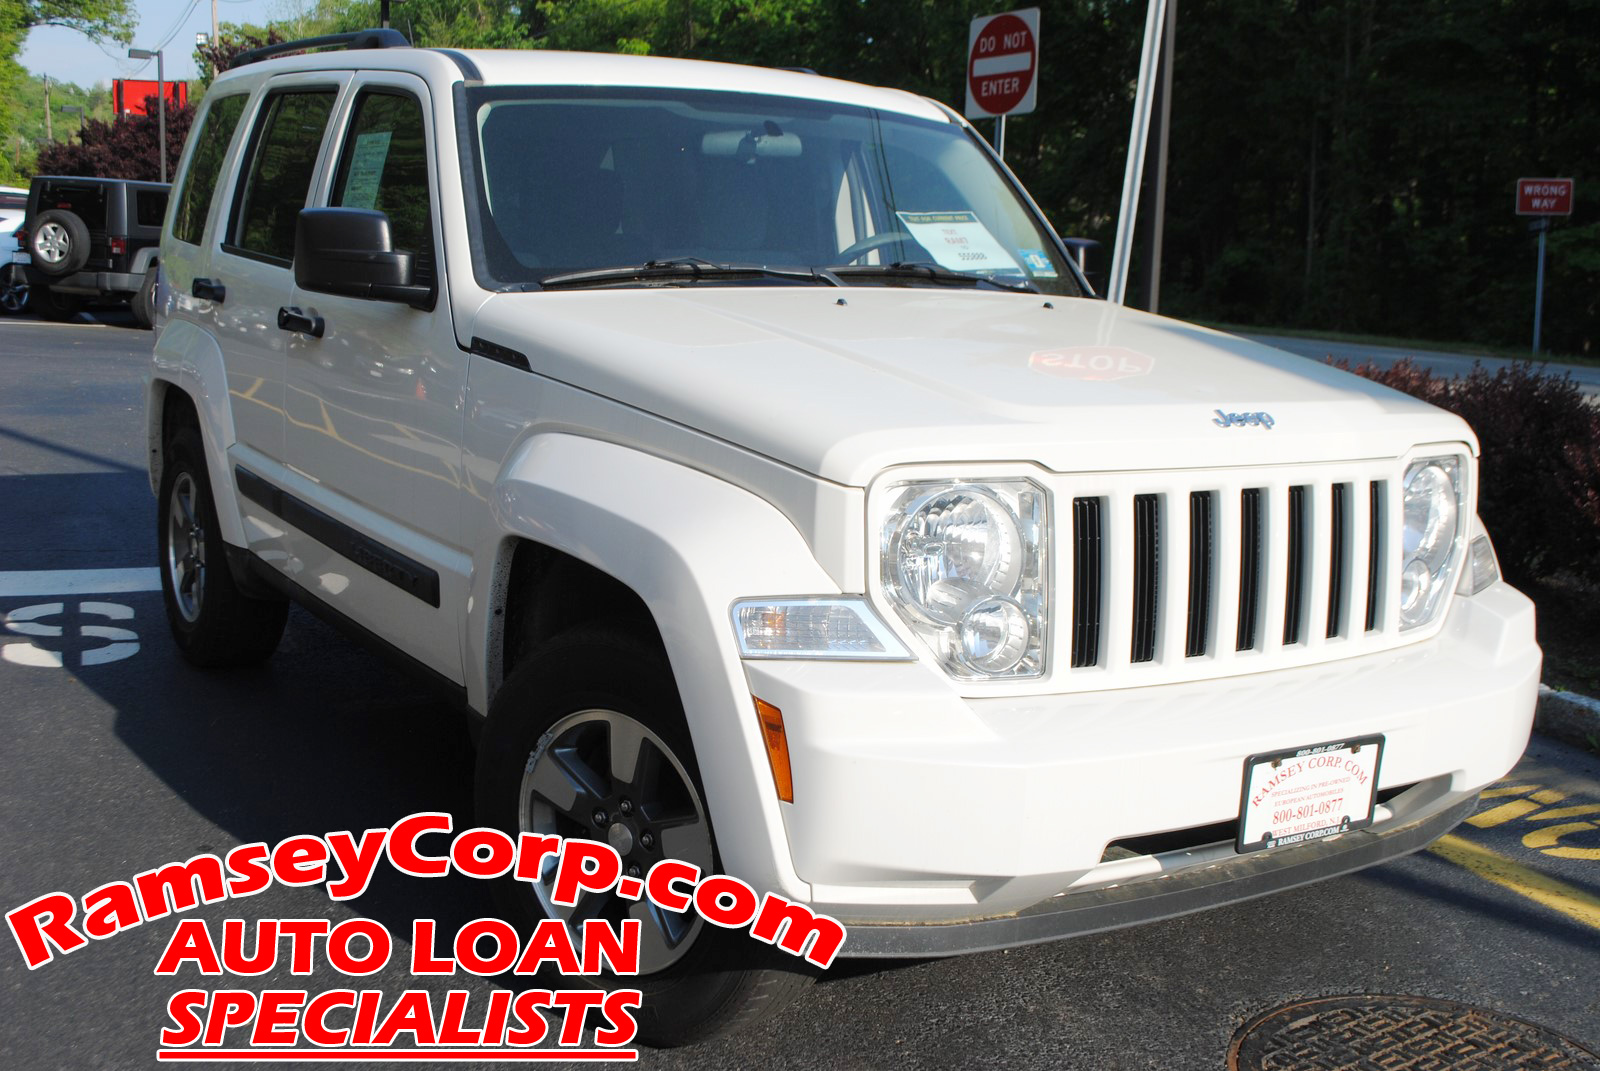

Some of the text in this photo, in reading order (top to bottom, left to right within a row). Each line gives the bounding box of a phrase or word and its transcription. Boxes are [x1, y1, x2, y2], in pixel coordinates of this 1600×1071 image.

[979, 31, 1028, 53] DO NOT
[981, 77, 1020, 97] ENTER
[1523, 184, 1567, 197] WRONG
[1531, 198, 1557, 209] WAY
[1212, 408, 1275, 430] Jeep
[1295, 743, 1346, 757] 800-801-0877
[1252, 761, 1306, 807] RAMSEY
[1344, 760, 1368, 785] COM
[1271, 785, 1310, 798] SPECIALIZING
[1318, 777, 1351, 788] PRE-OWNED
[1274, 788, 1344, 807] EUROPEAN AUTOMOBILES
[1272, 798, 1344, 824] 800-801-0877
[1272, 826, 1292, 837] WEST
[1277, 833, 1305, 847] RAMSEY
